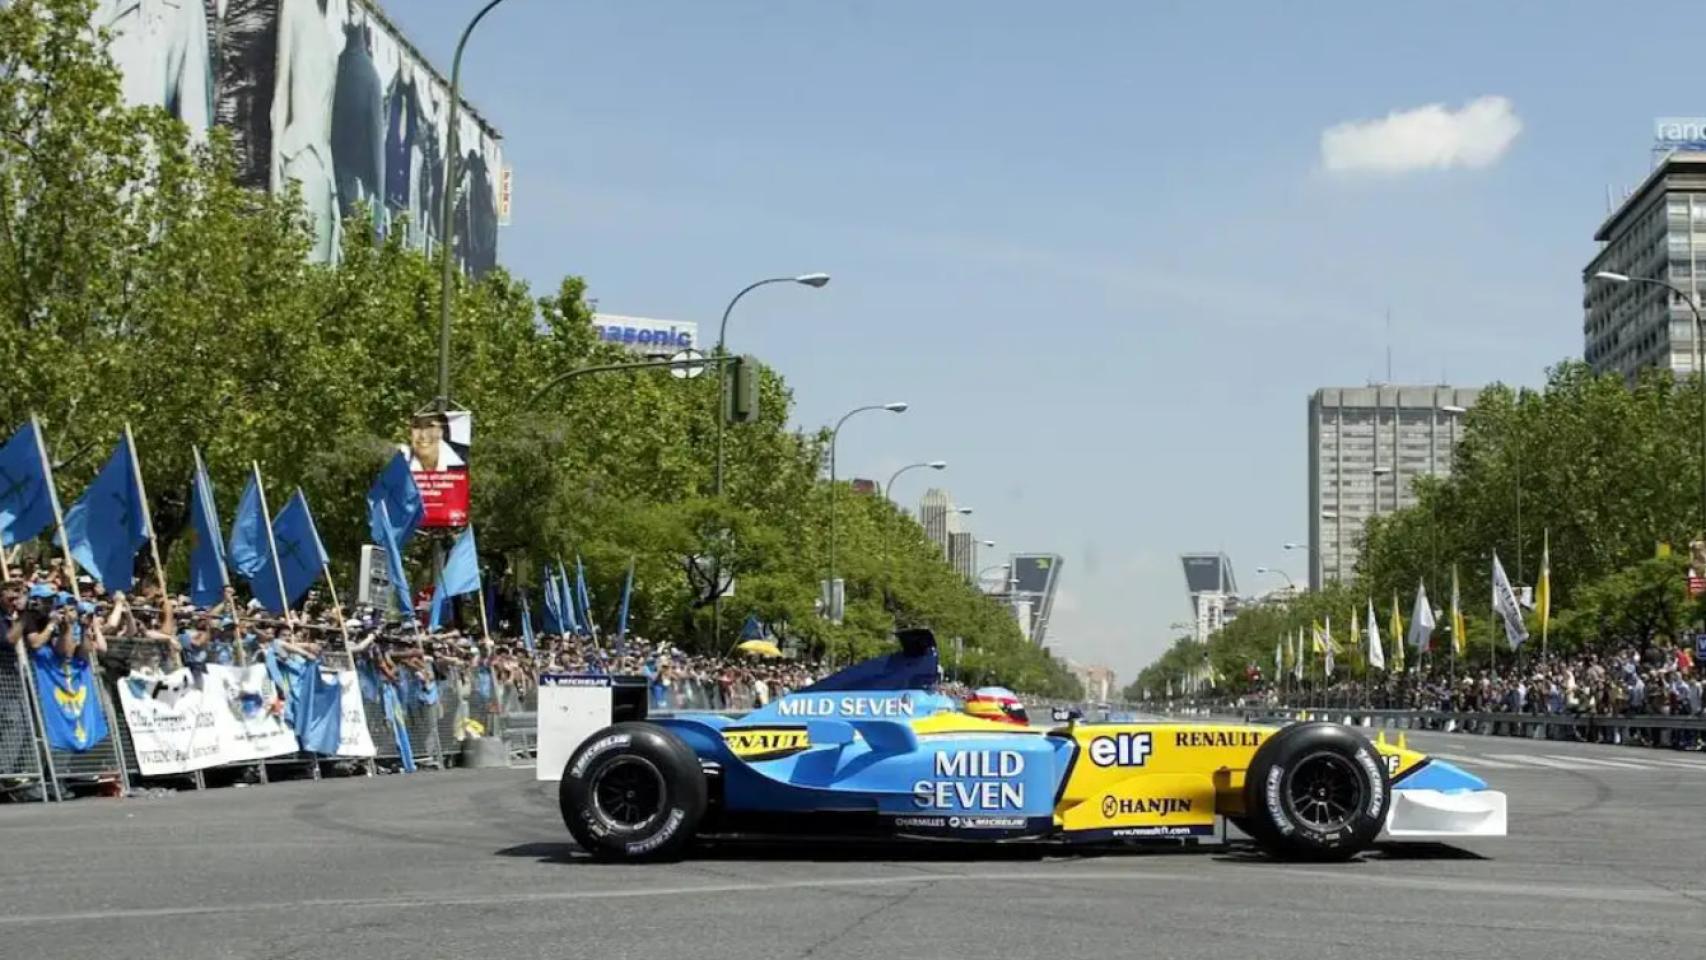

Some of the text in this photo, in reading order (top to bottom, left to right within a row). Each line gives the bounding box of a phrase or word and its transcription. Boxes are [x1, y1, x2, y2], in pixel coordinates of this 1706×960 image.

[778, 698, 914, 715] MILD SEVEN
[574, 734, 631, 772] MICHELIN
[1089, 733, 1151, 766] elf
[1176, 732, 1262, 746] RENAULT
[935, 751, 1024, 777] MILD
[913, 780, 1024, 809] SEVEN
[1266, 765, 1288, 829] MICHELIN
[1362, 755, 1383, 818] MICHELIN
[1119, 798, 1192, 816] HANJIN
